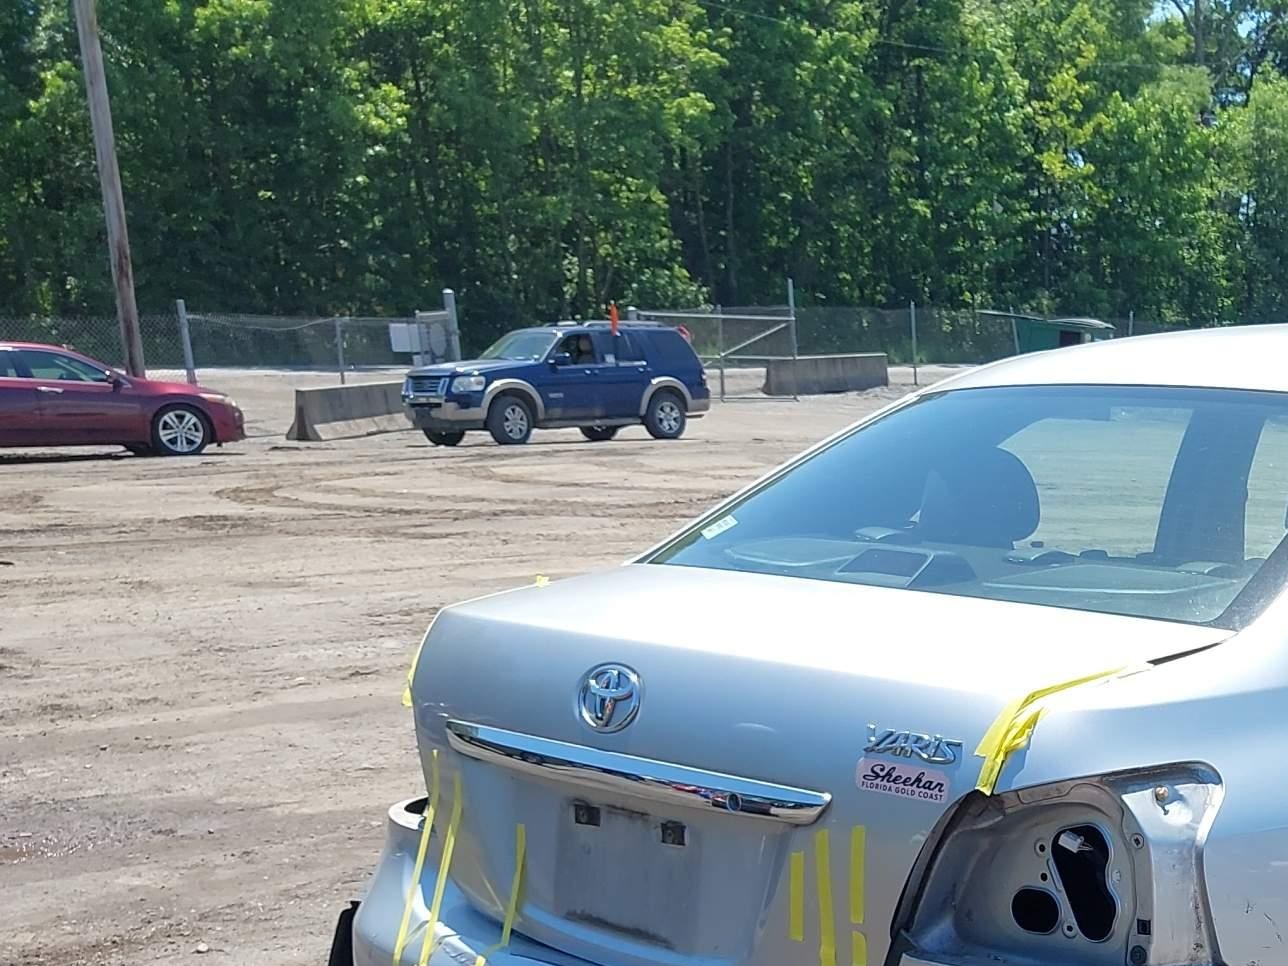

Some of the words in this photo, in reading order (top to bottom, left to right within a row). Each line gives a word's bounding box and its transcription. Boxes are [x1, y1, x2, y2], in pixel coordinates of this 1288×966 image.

[864, 723, 963, 765] YARIS
[861, 781, 893, 793] FLORIDA
[894, 786, 916, 797] GOLD
[917, 790, 944, 801] COAST
[862, 763, 945, 793] Sheehan
